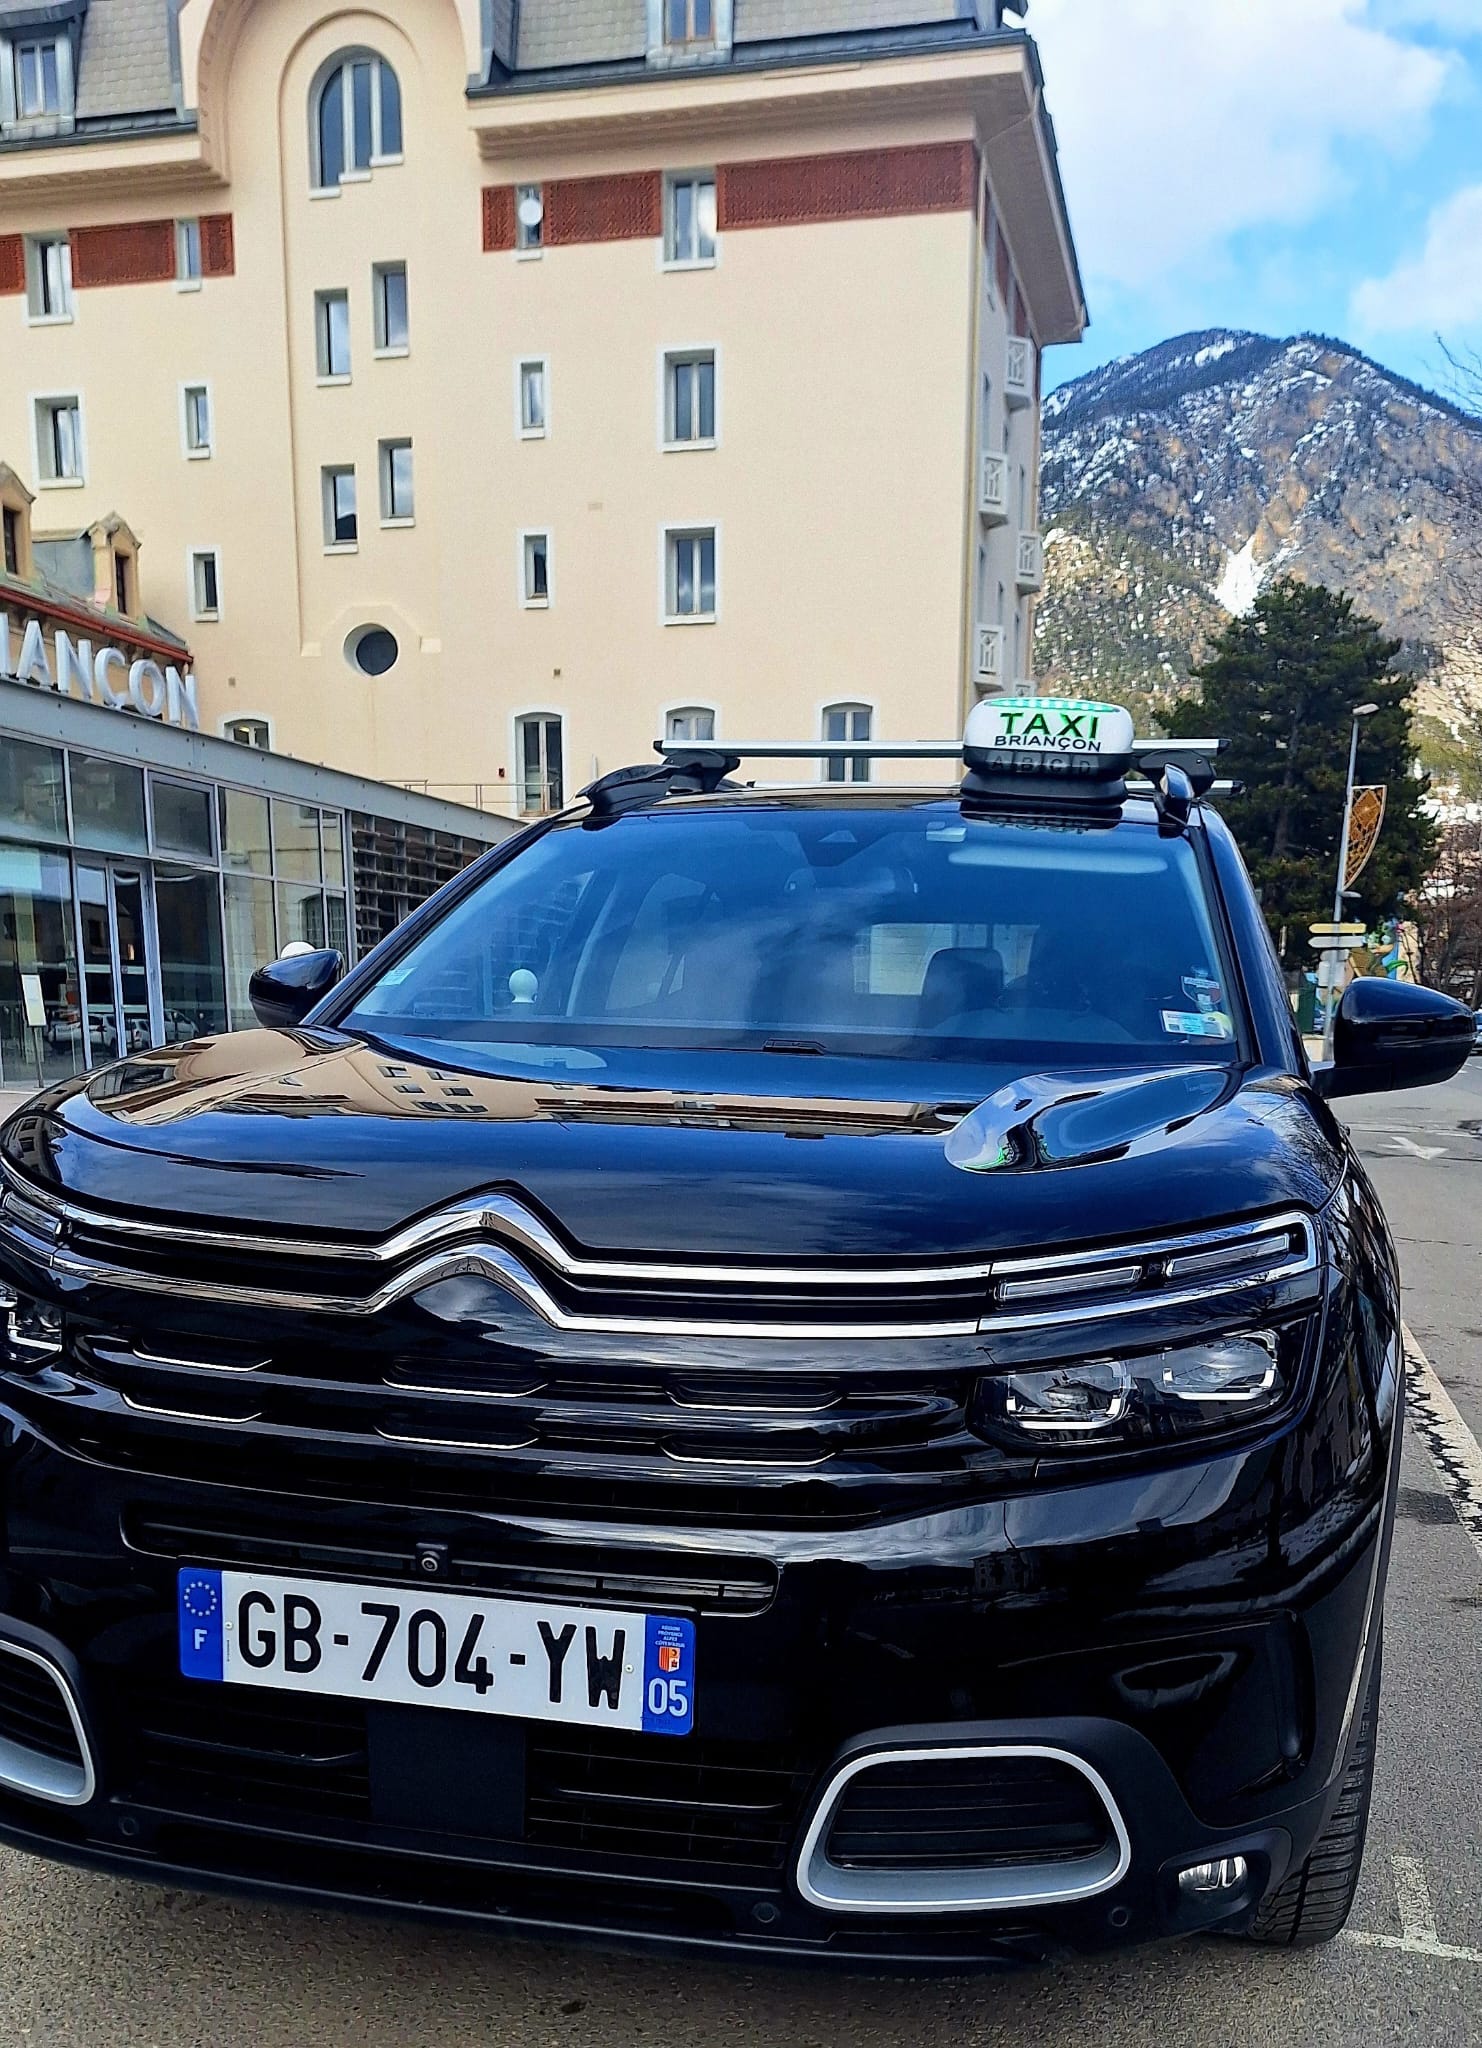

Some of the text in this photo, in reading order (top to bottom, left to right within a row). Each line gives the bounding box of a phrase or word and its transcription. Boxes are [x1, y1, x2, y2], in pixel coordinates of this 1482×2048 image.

[1000, 713, 1099, 739] TAXI
[994, 735, 1101, 752] BRIANÇON
[194, 1629, 207, 1650] F
[238, 1590, 626, 1711] GB-704-YW
[648, 1678, 688, 1717] 05
